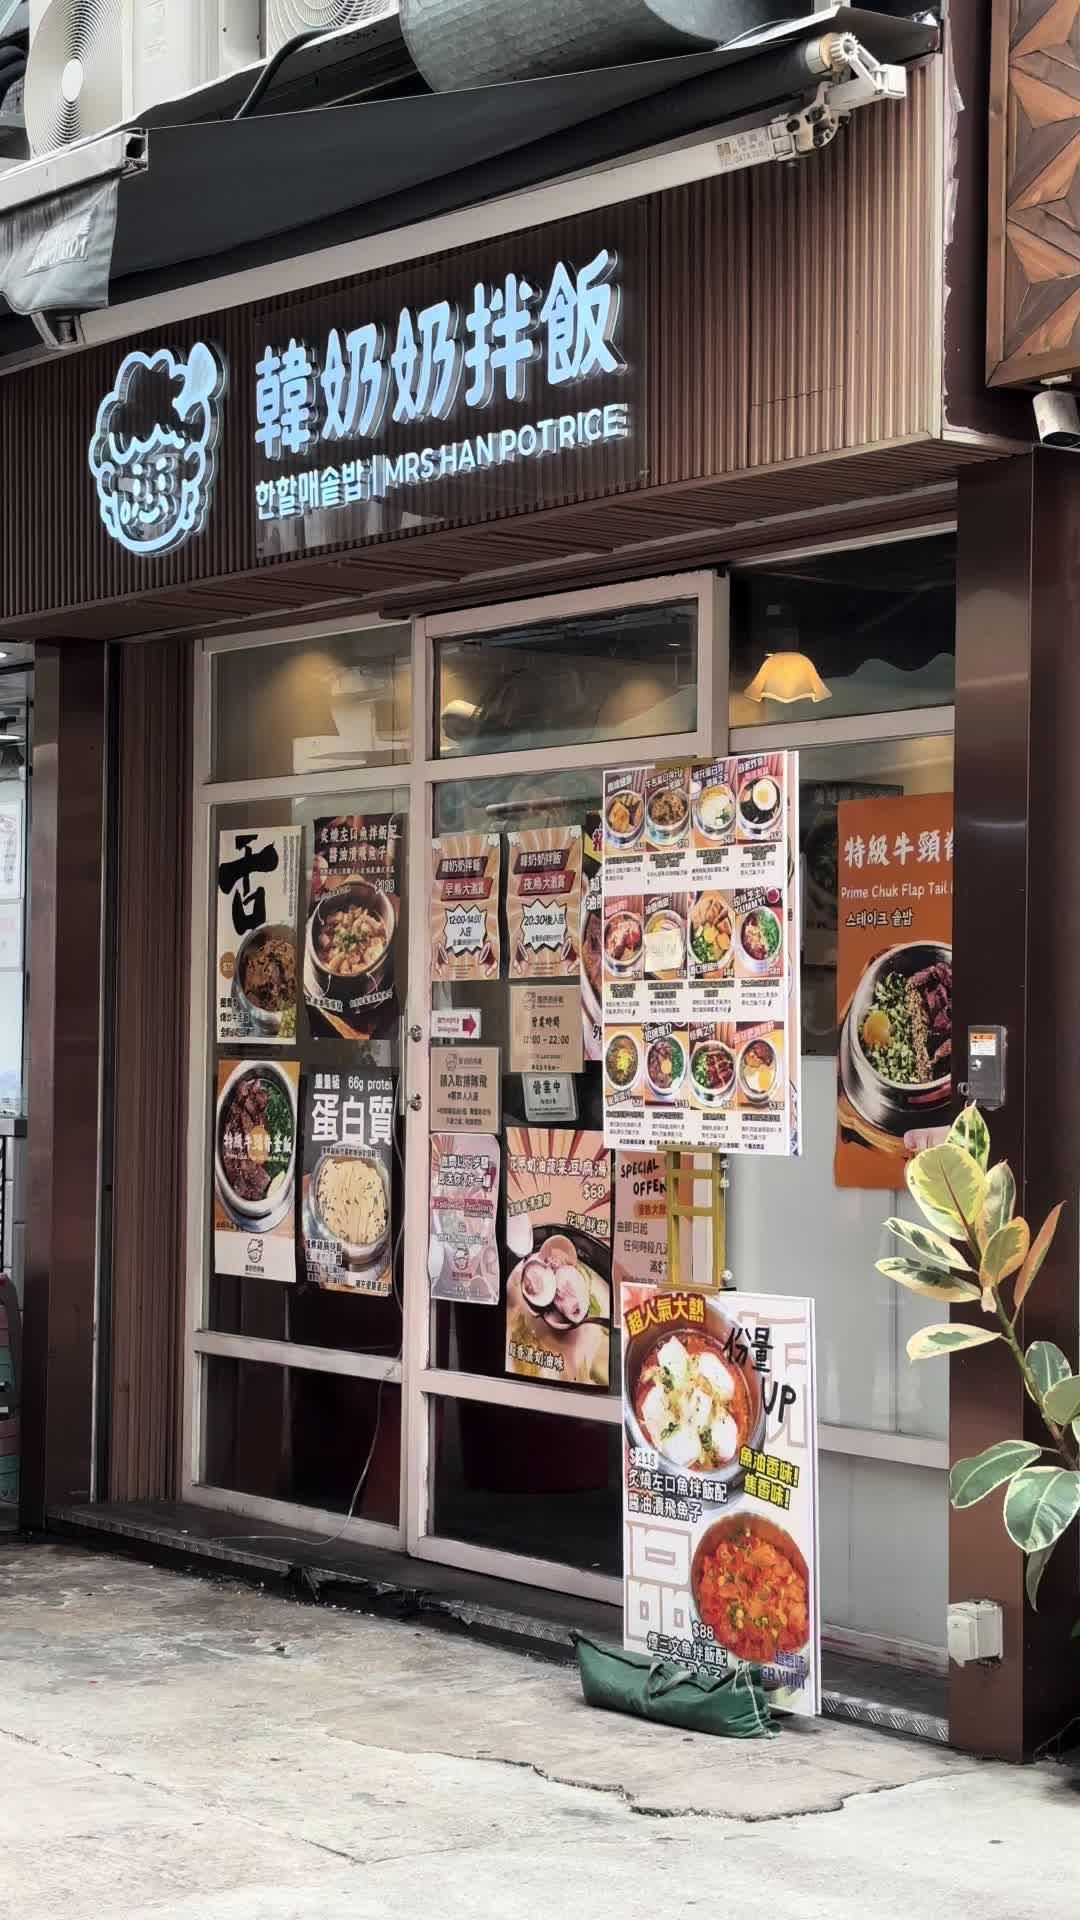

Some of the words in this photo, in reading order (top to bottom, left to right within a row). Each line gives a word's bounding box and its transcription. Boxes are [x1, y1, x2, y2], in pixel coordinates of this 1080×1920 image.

[255, 249, 622, 460] 韓奶奶拌飯
[385, 447, 436, 487] MRS
[439, 432, 496, 475] HAN
[255, 459, 365, 521] 한할매솥밥
[441, 858, 482, 873] 韓奶奶拌飯
[520, 851, 563, 868] 韓奶奶拌飯
[840, 887, 869, 900] Prime
[871, 884, 899, 897] Chuk
[901, 882, 925, 902] Flap
[928, 880, 948, 896] Tail
[735, 897, 766, 915] YUMMY!
[845, 908, 889, 930] 스테이크
[891, 906, 914, 928] 솥밥
[531, 1015, 561, 1029] 營業時間
[548, 1035, 570, 1045] 22:00
[348, 1075, 363, 1091] 66g
[532, 1079, 561, 1096] 營業中
[311, 1094, 393, 1147] 蛋白質
[620, 1157, 660, 1179] SPECIAL
[582, 1181, 606, 1200] $68
[625, 1294, 706, 1337] 超人氣大熱
[723, 1326, 774, 1374] 份量
[761, 1376, 797, 1424] UP
[739, 1444, 800, 1489] 魚油香味!
[628, 1468, 728, 1504] 炙燒左口魚拌飯配
[627, 1490, 703, 1523] 醬油漬飛魚子
[691, 1620, 715, 1642] $88
